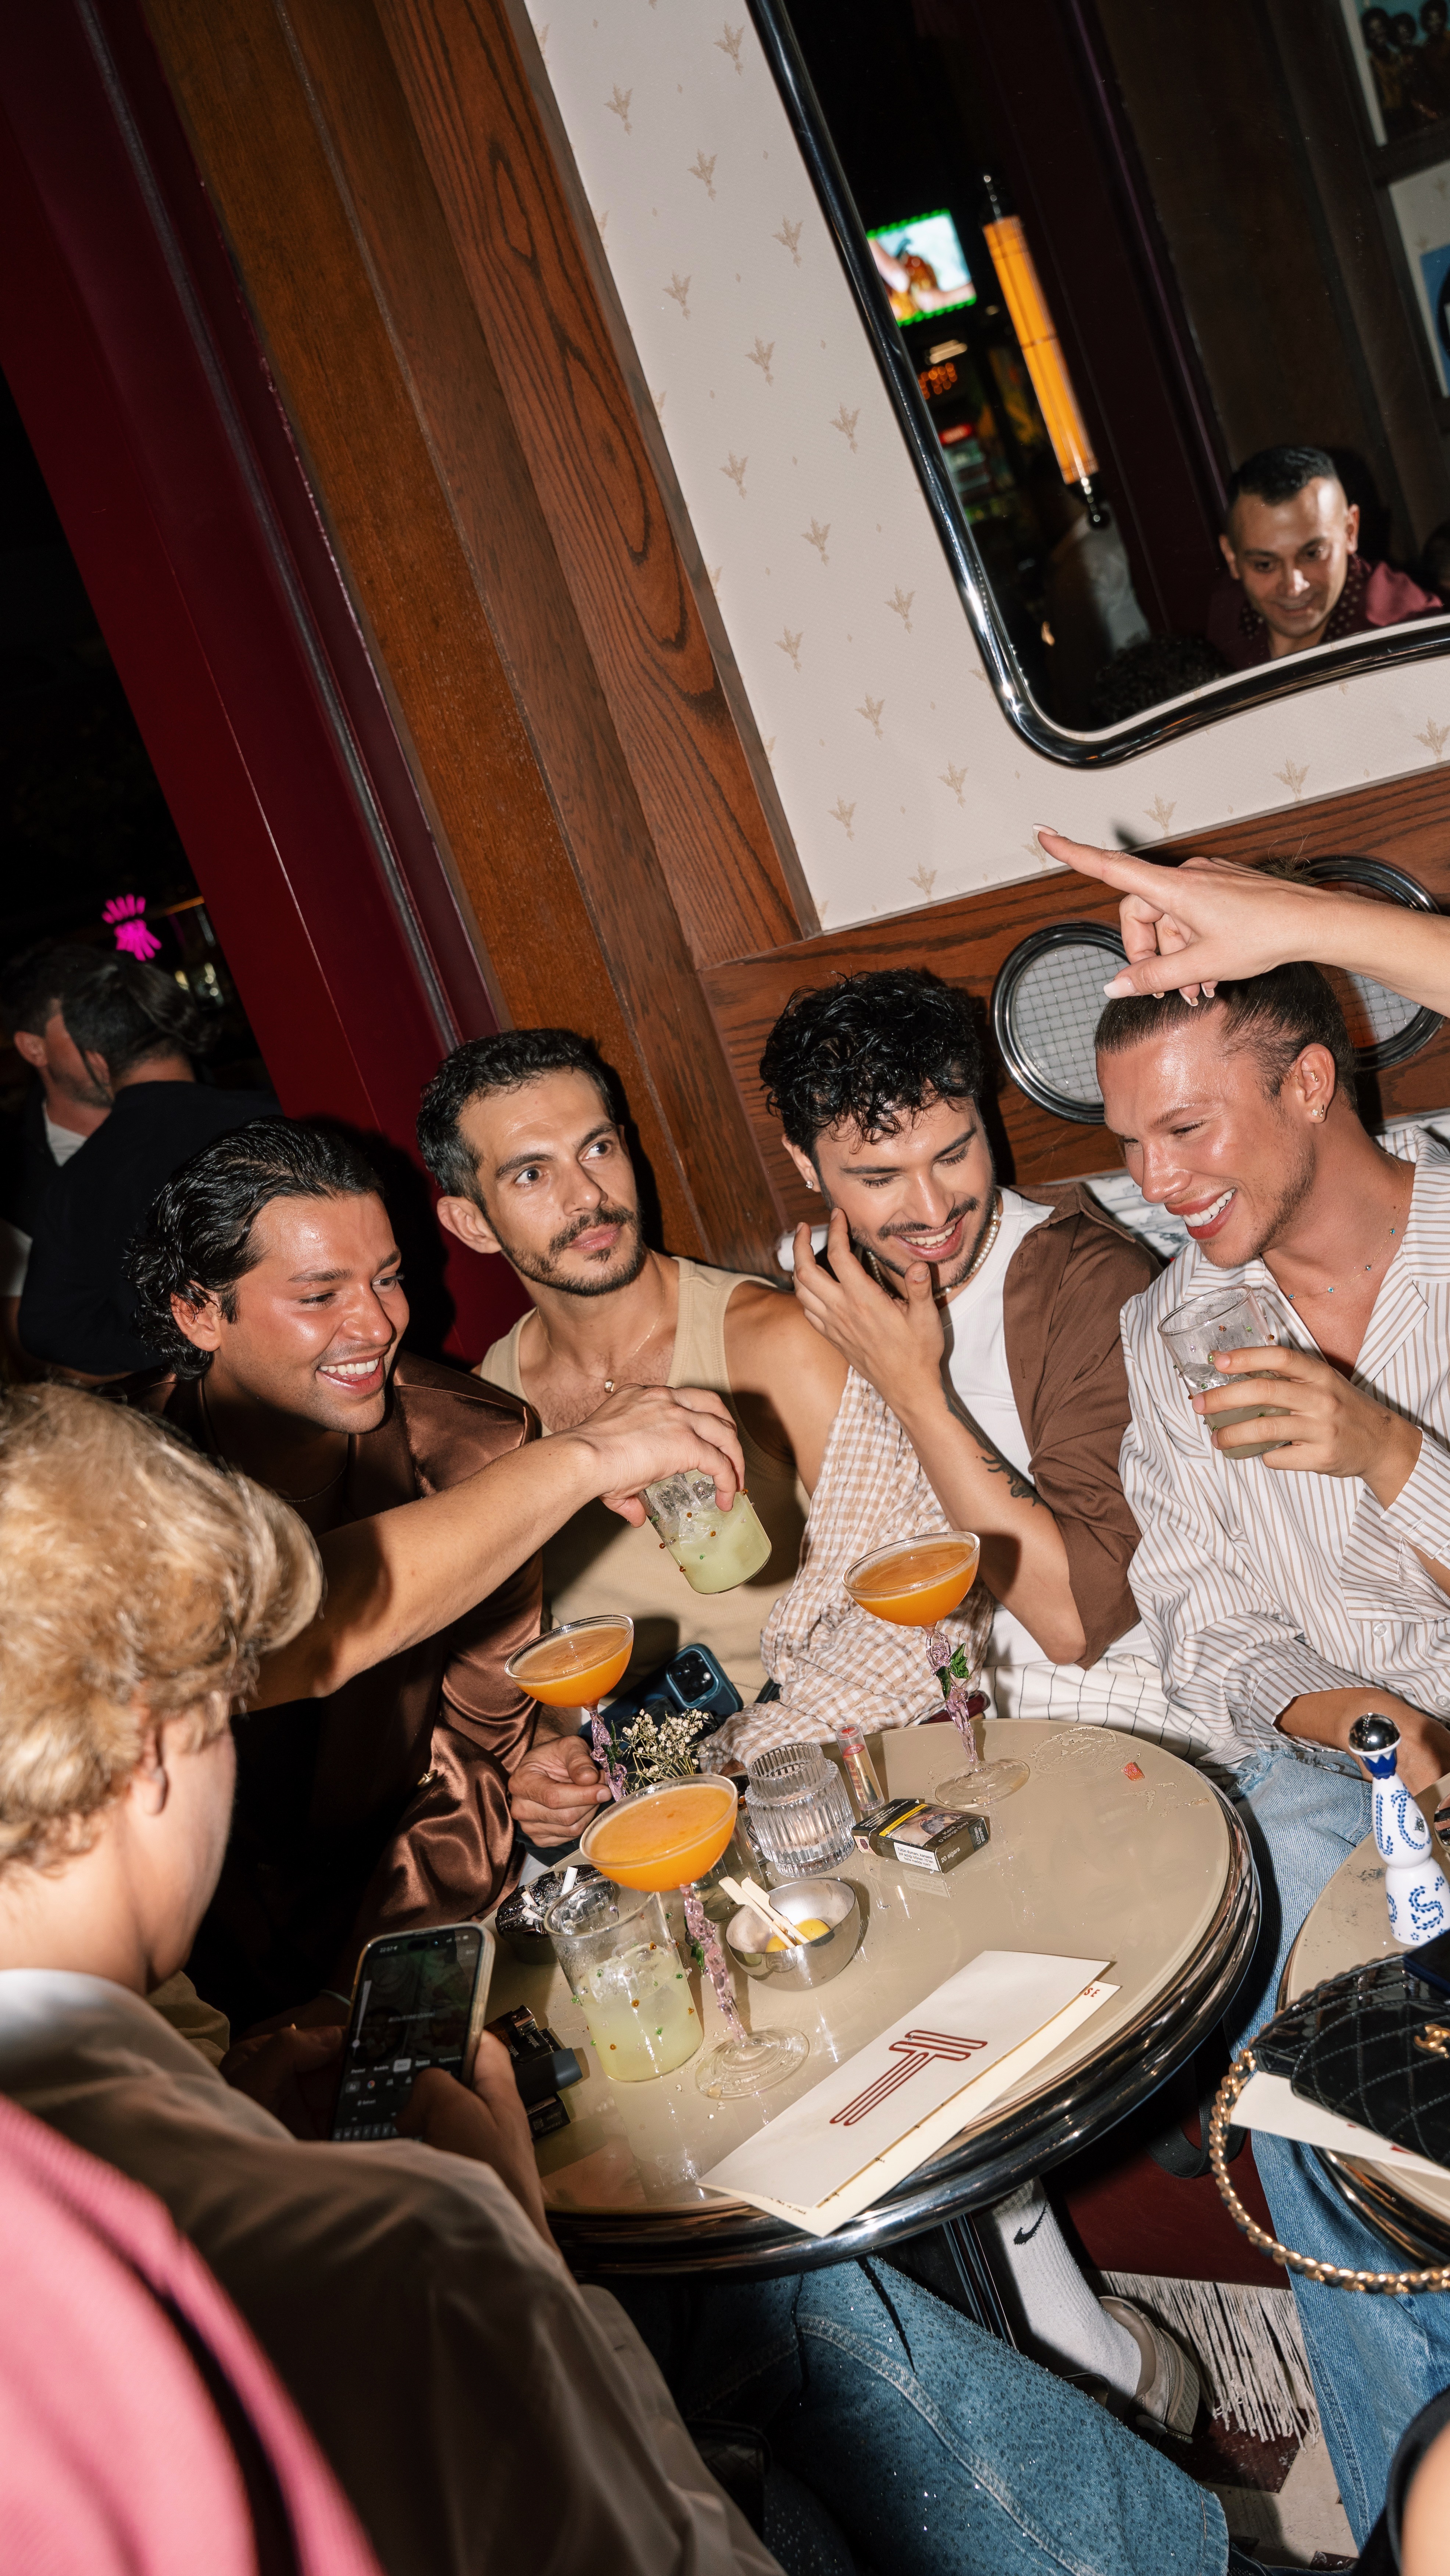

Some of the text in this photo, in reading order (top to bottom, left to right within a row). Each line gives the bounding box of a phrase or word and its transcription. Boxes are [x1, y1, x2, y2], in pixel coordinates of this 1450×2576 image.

[942, 1826, 956, 1835] Kent
[943, 1829, 958, 1839] Range
[947, 1847, 961, 1858] sigara
